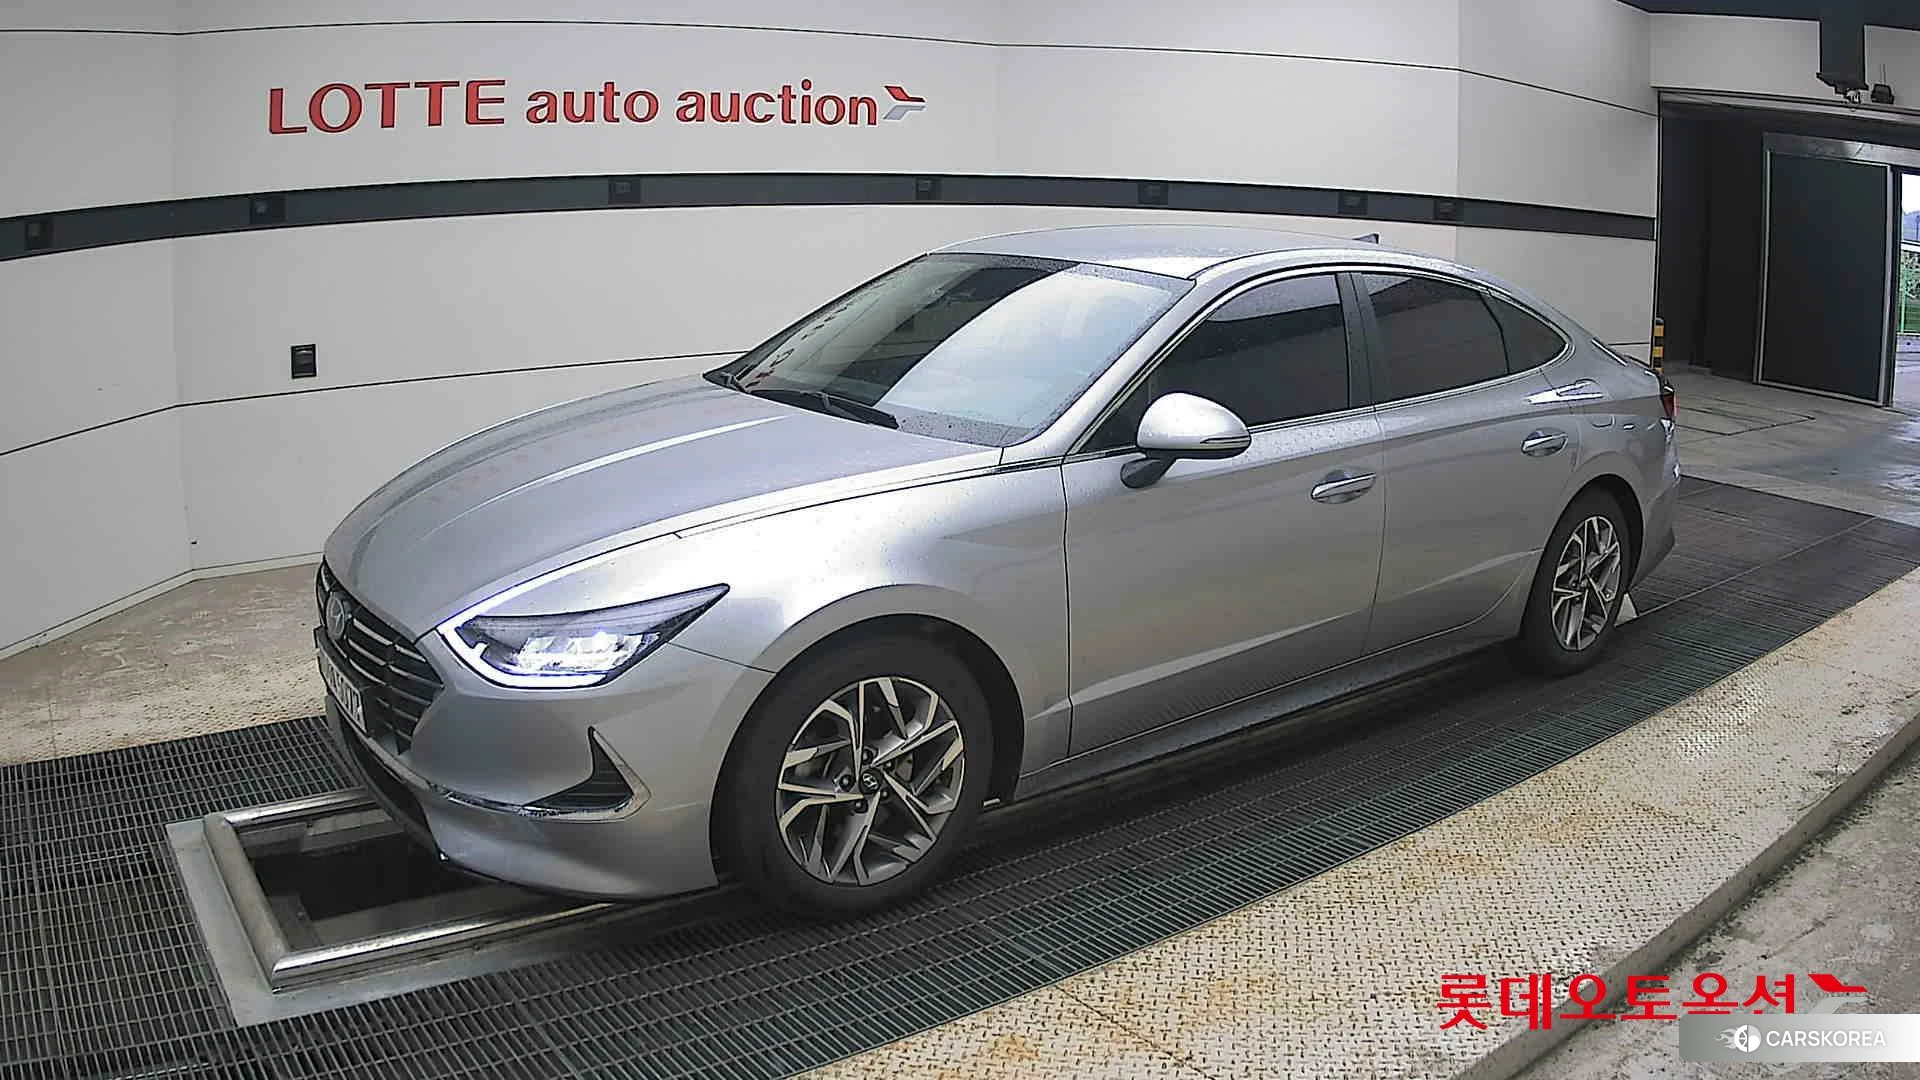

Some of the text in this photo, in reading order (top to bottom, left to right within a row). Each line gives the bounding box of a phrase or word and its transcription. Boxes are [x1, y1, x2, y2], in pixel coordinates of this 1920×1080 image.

[268, 79, 878, 135] LOTTE auto auction
